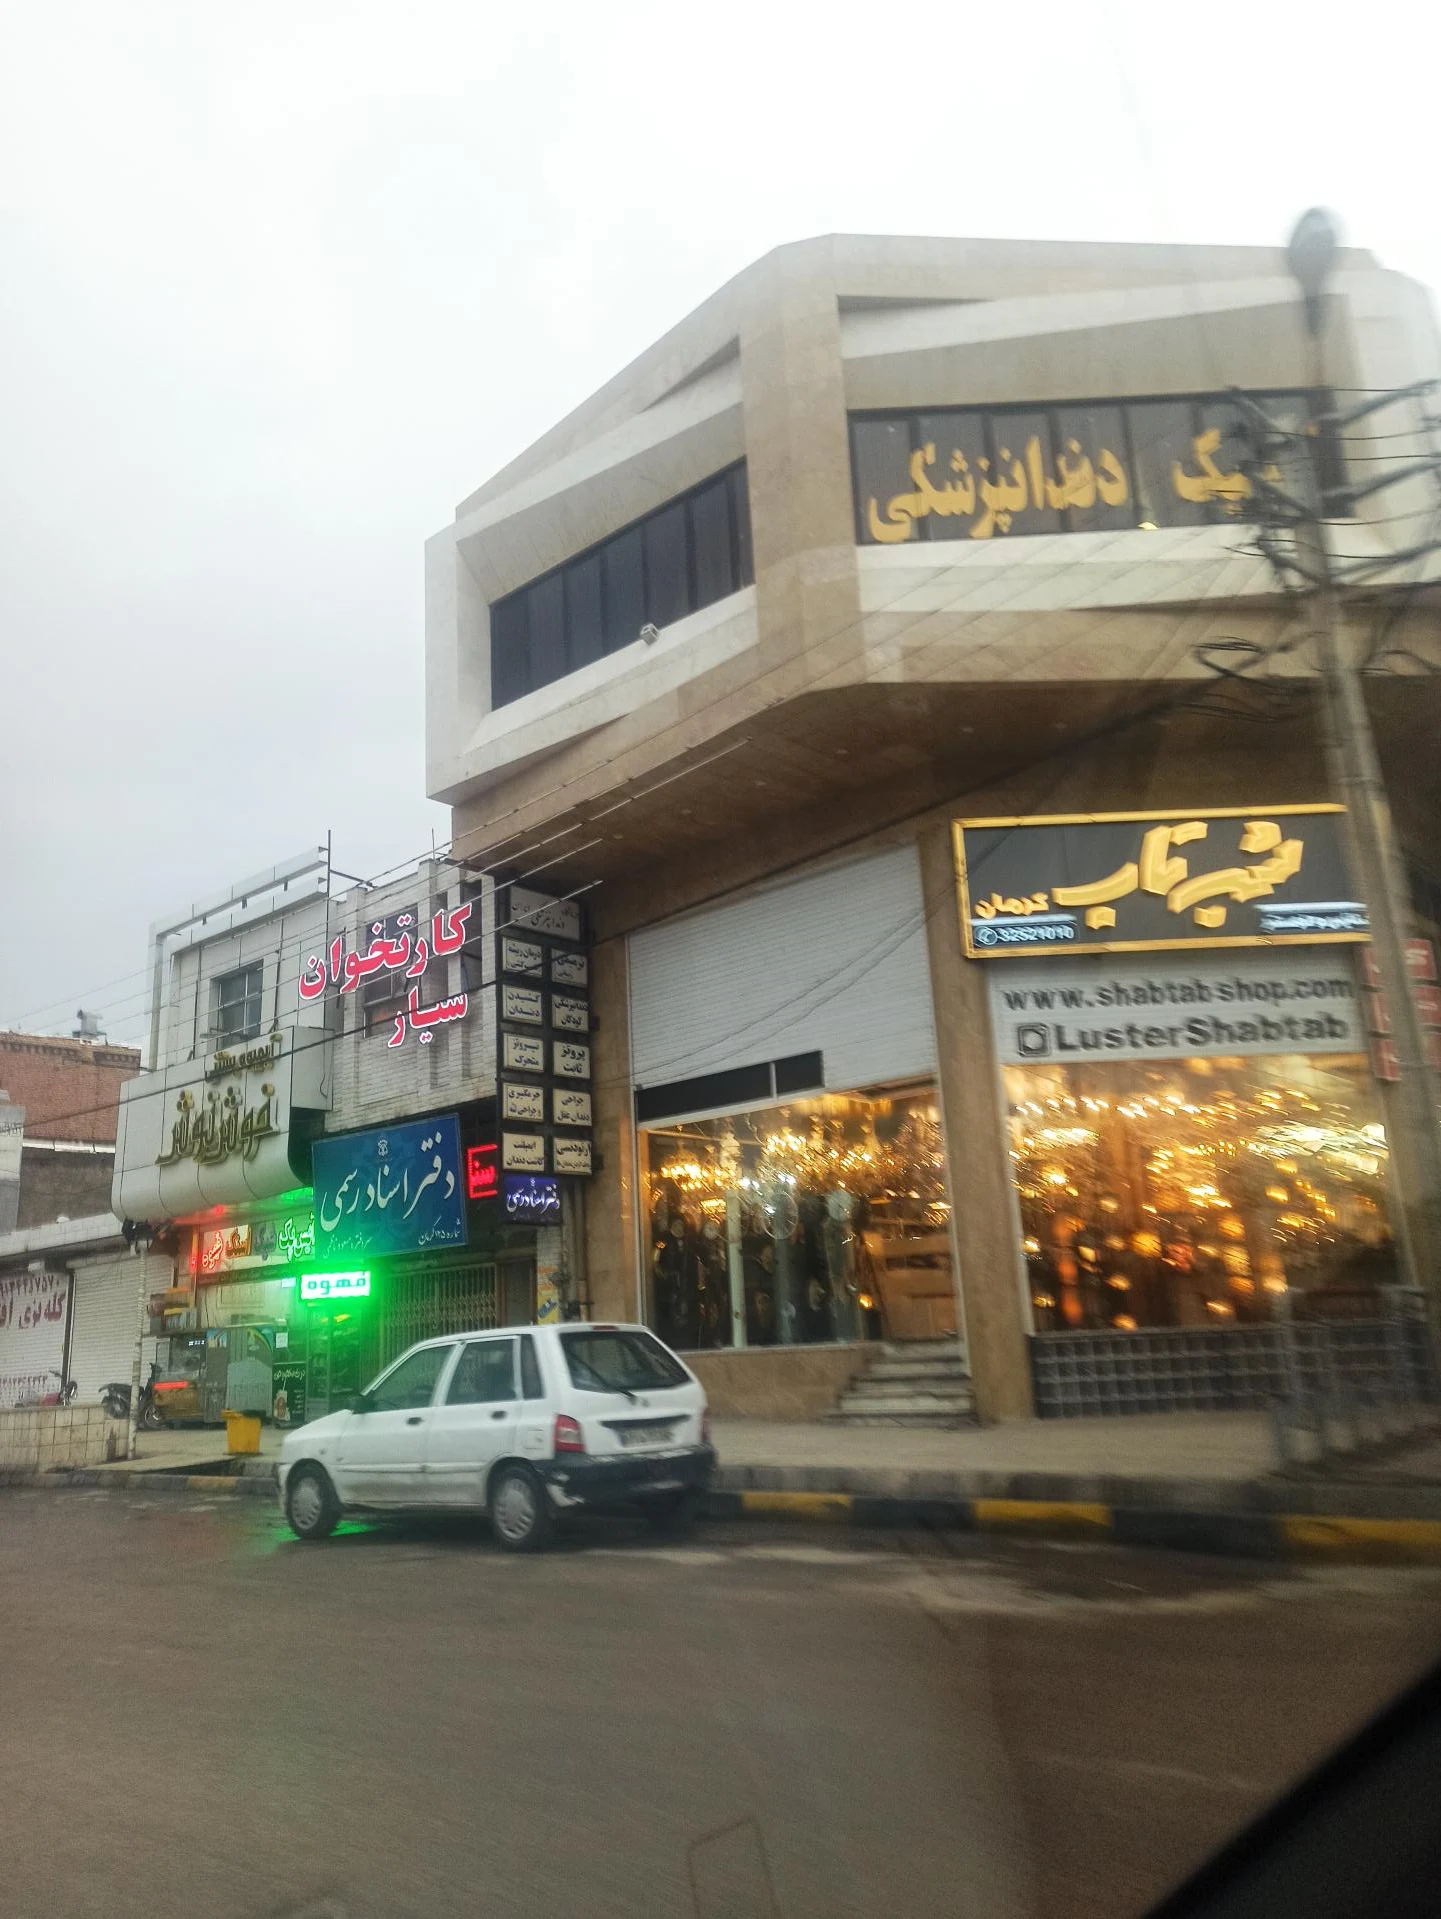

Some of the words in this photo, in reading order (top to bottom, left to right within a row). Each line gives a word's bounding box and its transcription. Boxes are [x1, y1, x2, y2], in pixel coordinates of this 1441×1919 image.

[868, 435, 1128, 543] دندانپزشکی
[975, 892, 1049, 920] کرمان
[387, 985, 469, 1048] سیار
[509, 1005, 540, 1017] دندان
[1054, 1010, 1349, 1048] LusterShabtab
[560, 1045, 586, 1058] پروتز
[364, 1164, 408, 1212] اسناد
[403, 1131, 455, 1219] دفتر
[320, 1167, 360, 1232] رسمی
[307, 1272, 366, 1296] قهوه
